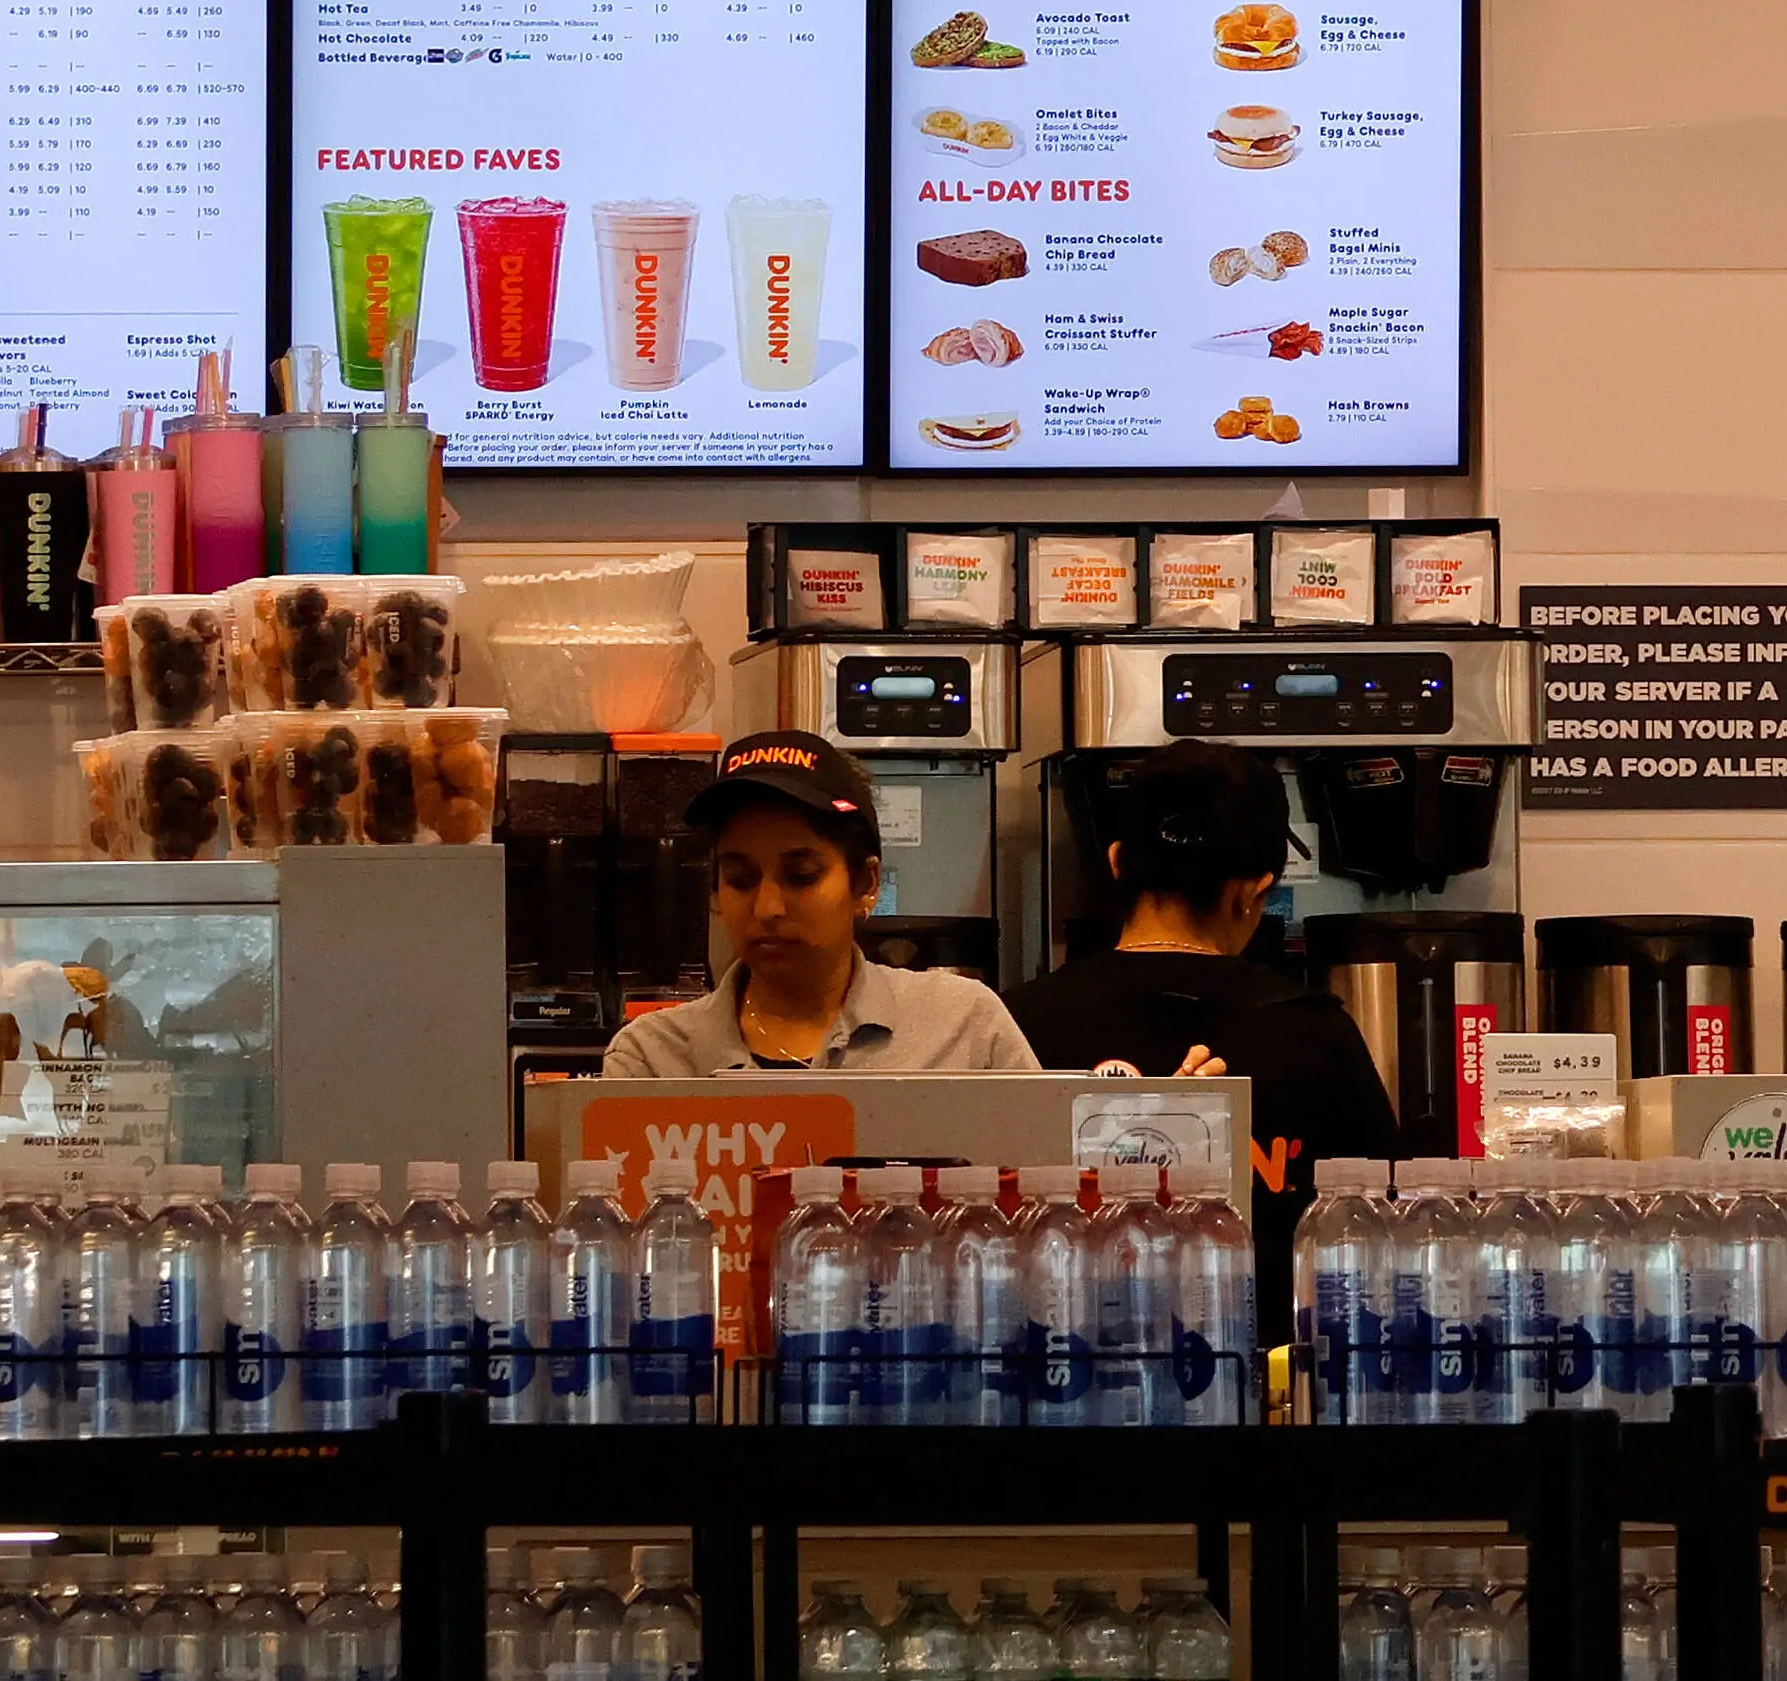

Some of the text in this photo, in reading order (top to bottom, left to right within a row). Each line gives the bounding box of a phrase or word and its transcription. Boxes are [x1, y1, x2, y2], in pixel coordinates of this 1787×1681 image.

[1037, 13, 1131, 24] Avocado Toast
[319, 34, 413, 45] Hot Chocolate
[1036, 110, 1118, 120] Omelet Bites
[318, 149, 561, 172] FEATURED FAVES
[919, 180, 1131, 203] ALL-DAY BITES
[1046, 235, 1164, 246] Banana Chocolate
[1046, 250, 1117, 263] Chip Bread
[766, 251, 793, 366] DUNKIN'
[749, 400, 808, 410] Lemonade
[1329, 401, 1410, 412] Hash Browns
[26, 492, 53, 612] DUNKIN'
[1531, 606, 1636, 625] BEFORE
[1644, 606, 1759, 625] PLACING
[387, 612, 401, 643] ICED
[1638, 643, 1740, 662] PLEASE
[1615, 682, 1721, 701] SERVER
[1728, 682, 1751, 700] IF
[1757, 681, 1778, 700] A
[1544, 720, 1638, 739] ERSON
[1646, 720, 1672, 739] IN
[1679, 720, 1754, 739] YOUR
[727, 747, 819, 773] DUNKIN'
[1531, 758, 1586, 776] HAS
[1593, 758, 1613, 776] A
[1622, 758, 1697, 777] FOOD
[1462, 1017, 1477, 1085] BLEND
[1552, 1055, 1602, 1070] $4.39
[645, 1122, 786, 1166] WHY
[1724, 1124, 1774, 1149] we
